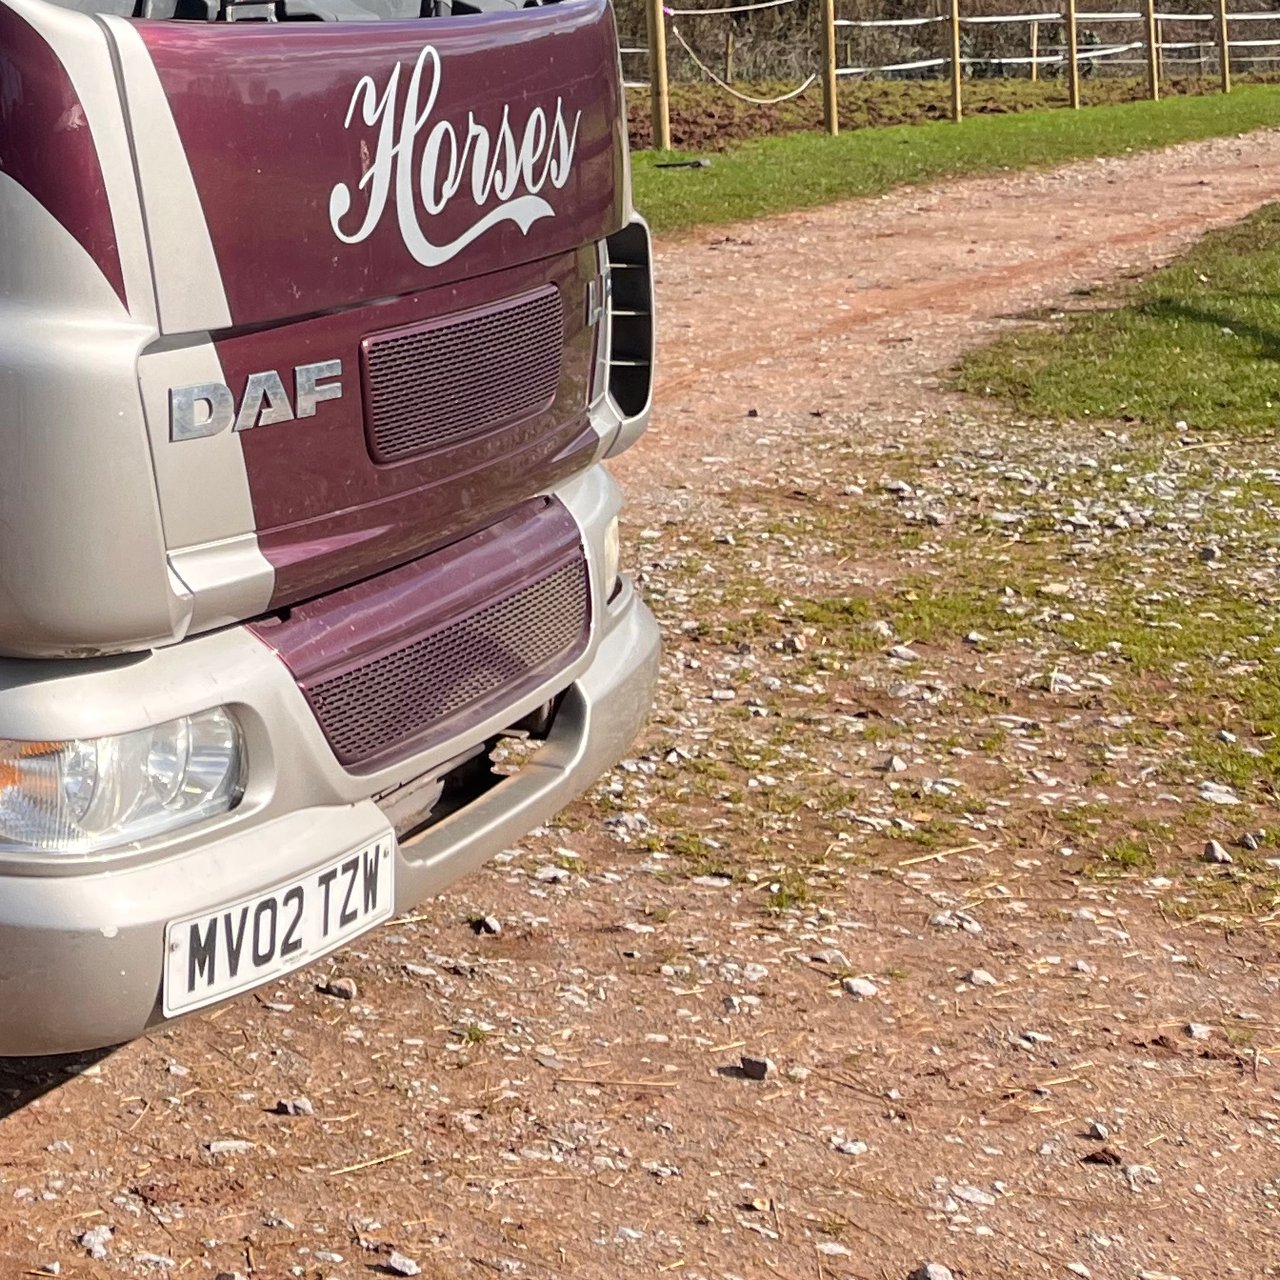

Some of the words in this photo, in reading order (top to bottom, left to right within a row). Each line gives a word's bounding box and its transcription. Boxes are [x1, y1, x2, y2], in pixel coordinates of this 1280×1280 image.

[329, 45, 582, 266] Horses
[169, 359, 342, 443] DAF
[188, 885, 304, 993] MV02
[318, 844, 381, 938] TZW
